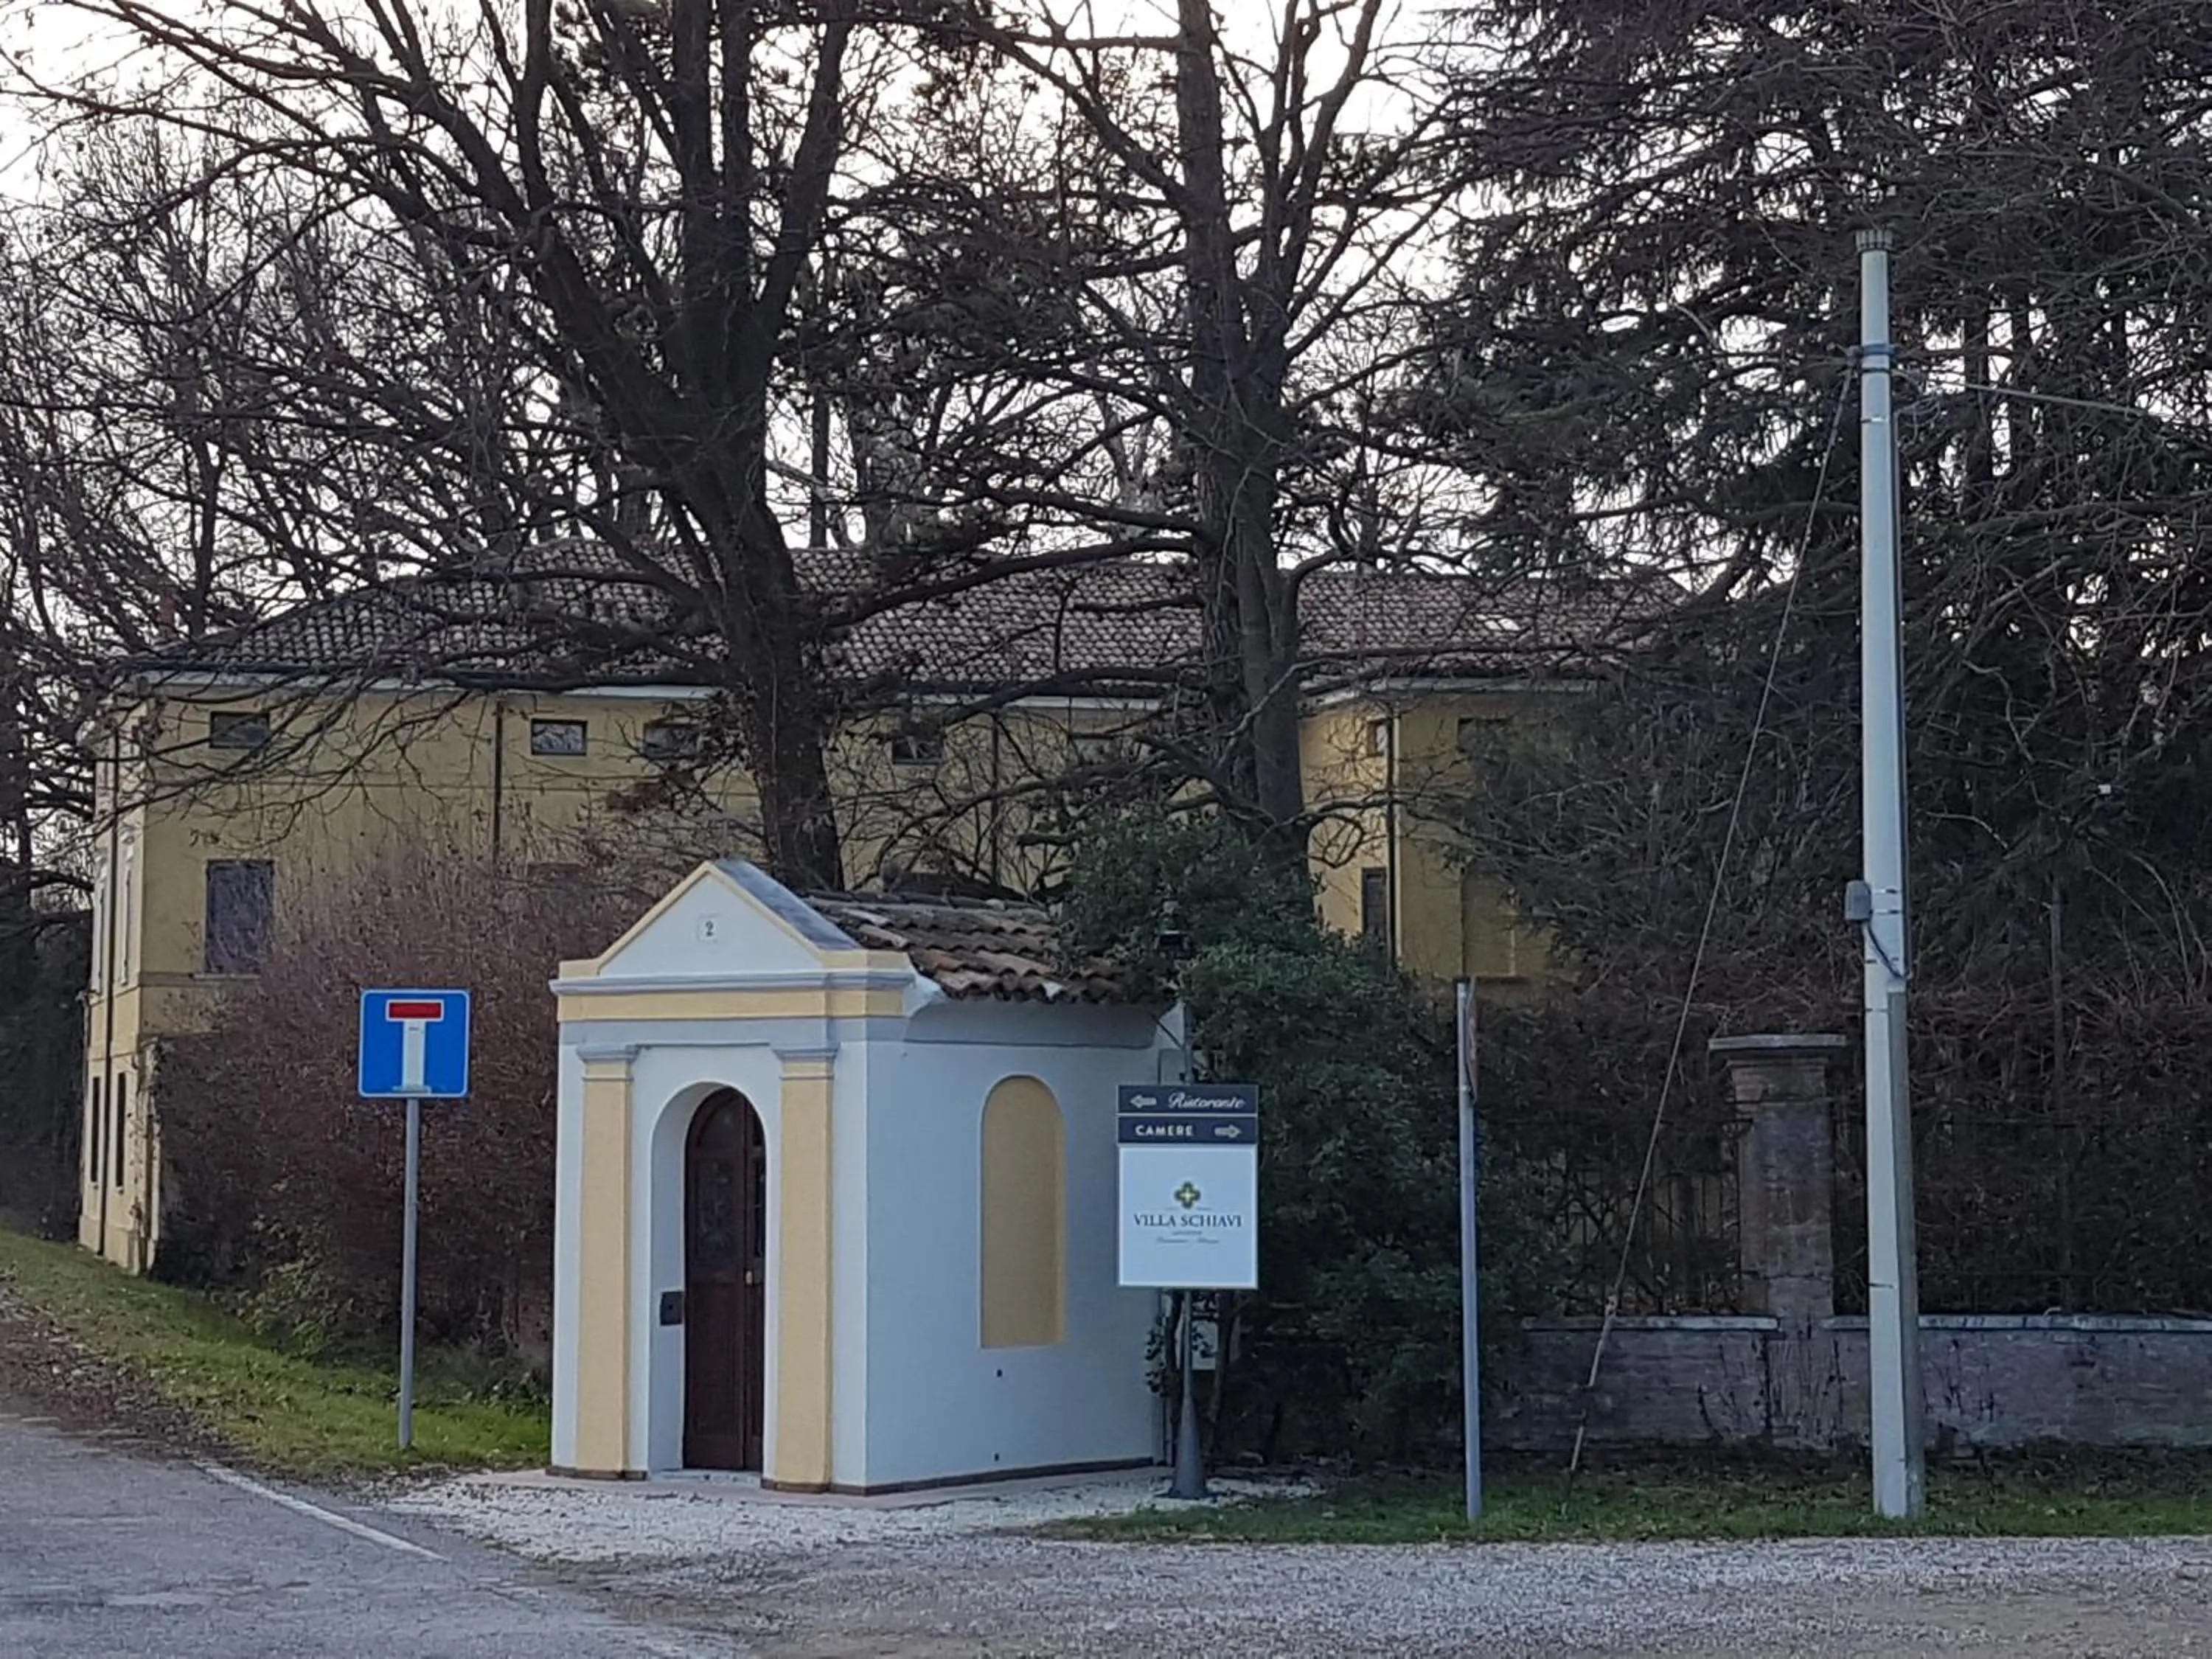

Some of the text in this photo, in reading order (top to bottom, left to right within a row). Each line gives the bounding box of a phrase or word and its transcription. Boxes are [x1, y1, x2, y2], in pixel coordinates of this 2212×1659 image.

[705, 919, 714, 937] 2
[1168, 1092, 1246, 1109] Ristorante
[1135, 1124, 1194, 1137] CAMERE
[1133, 1214, 1243, 1228] VILLA SCHIAVI
